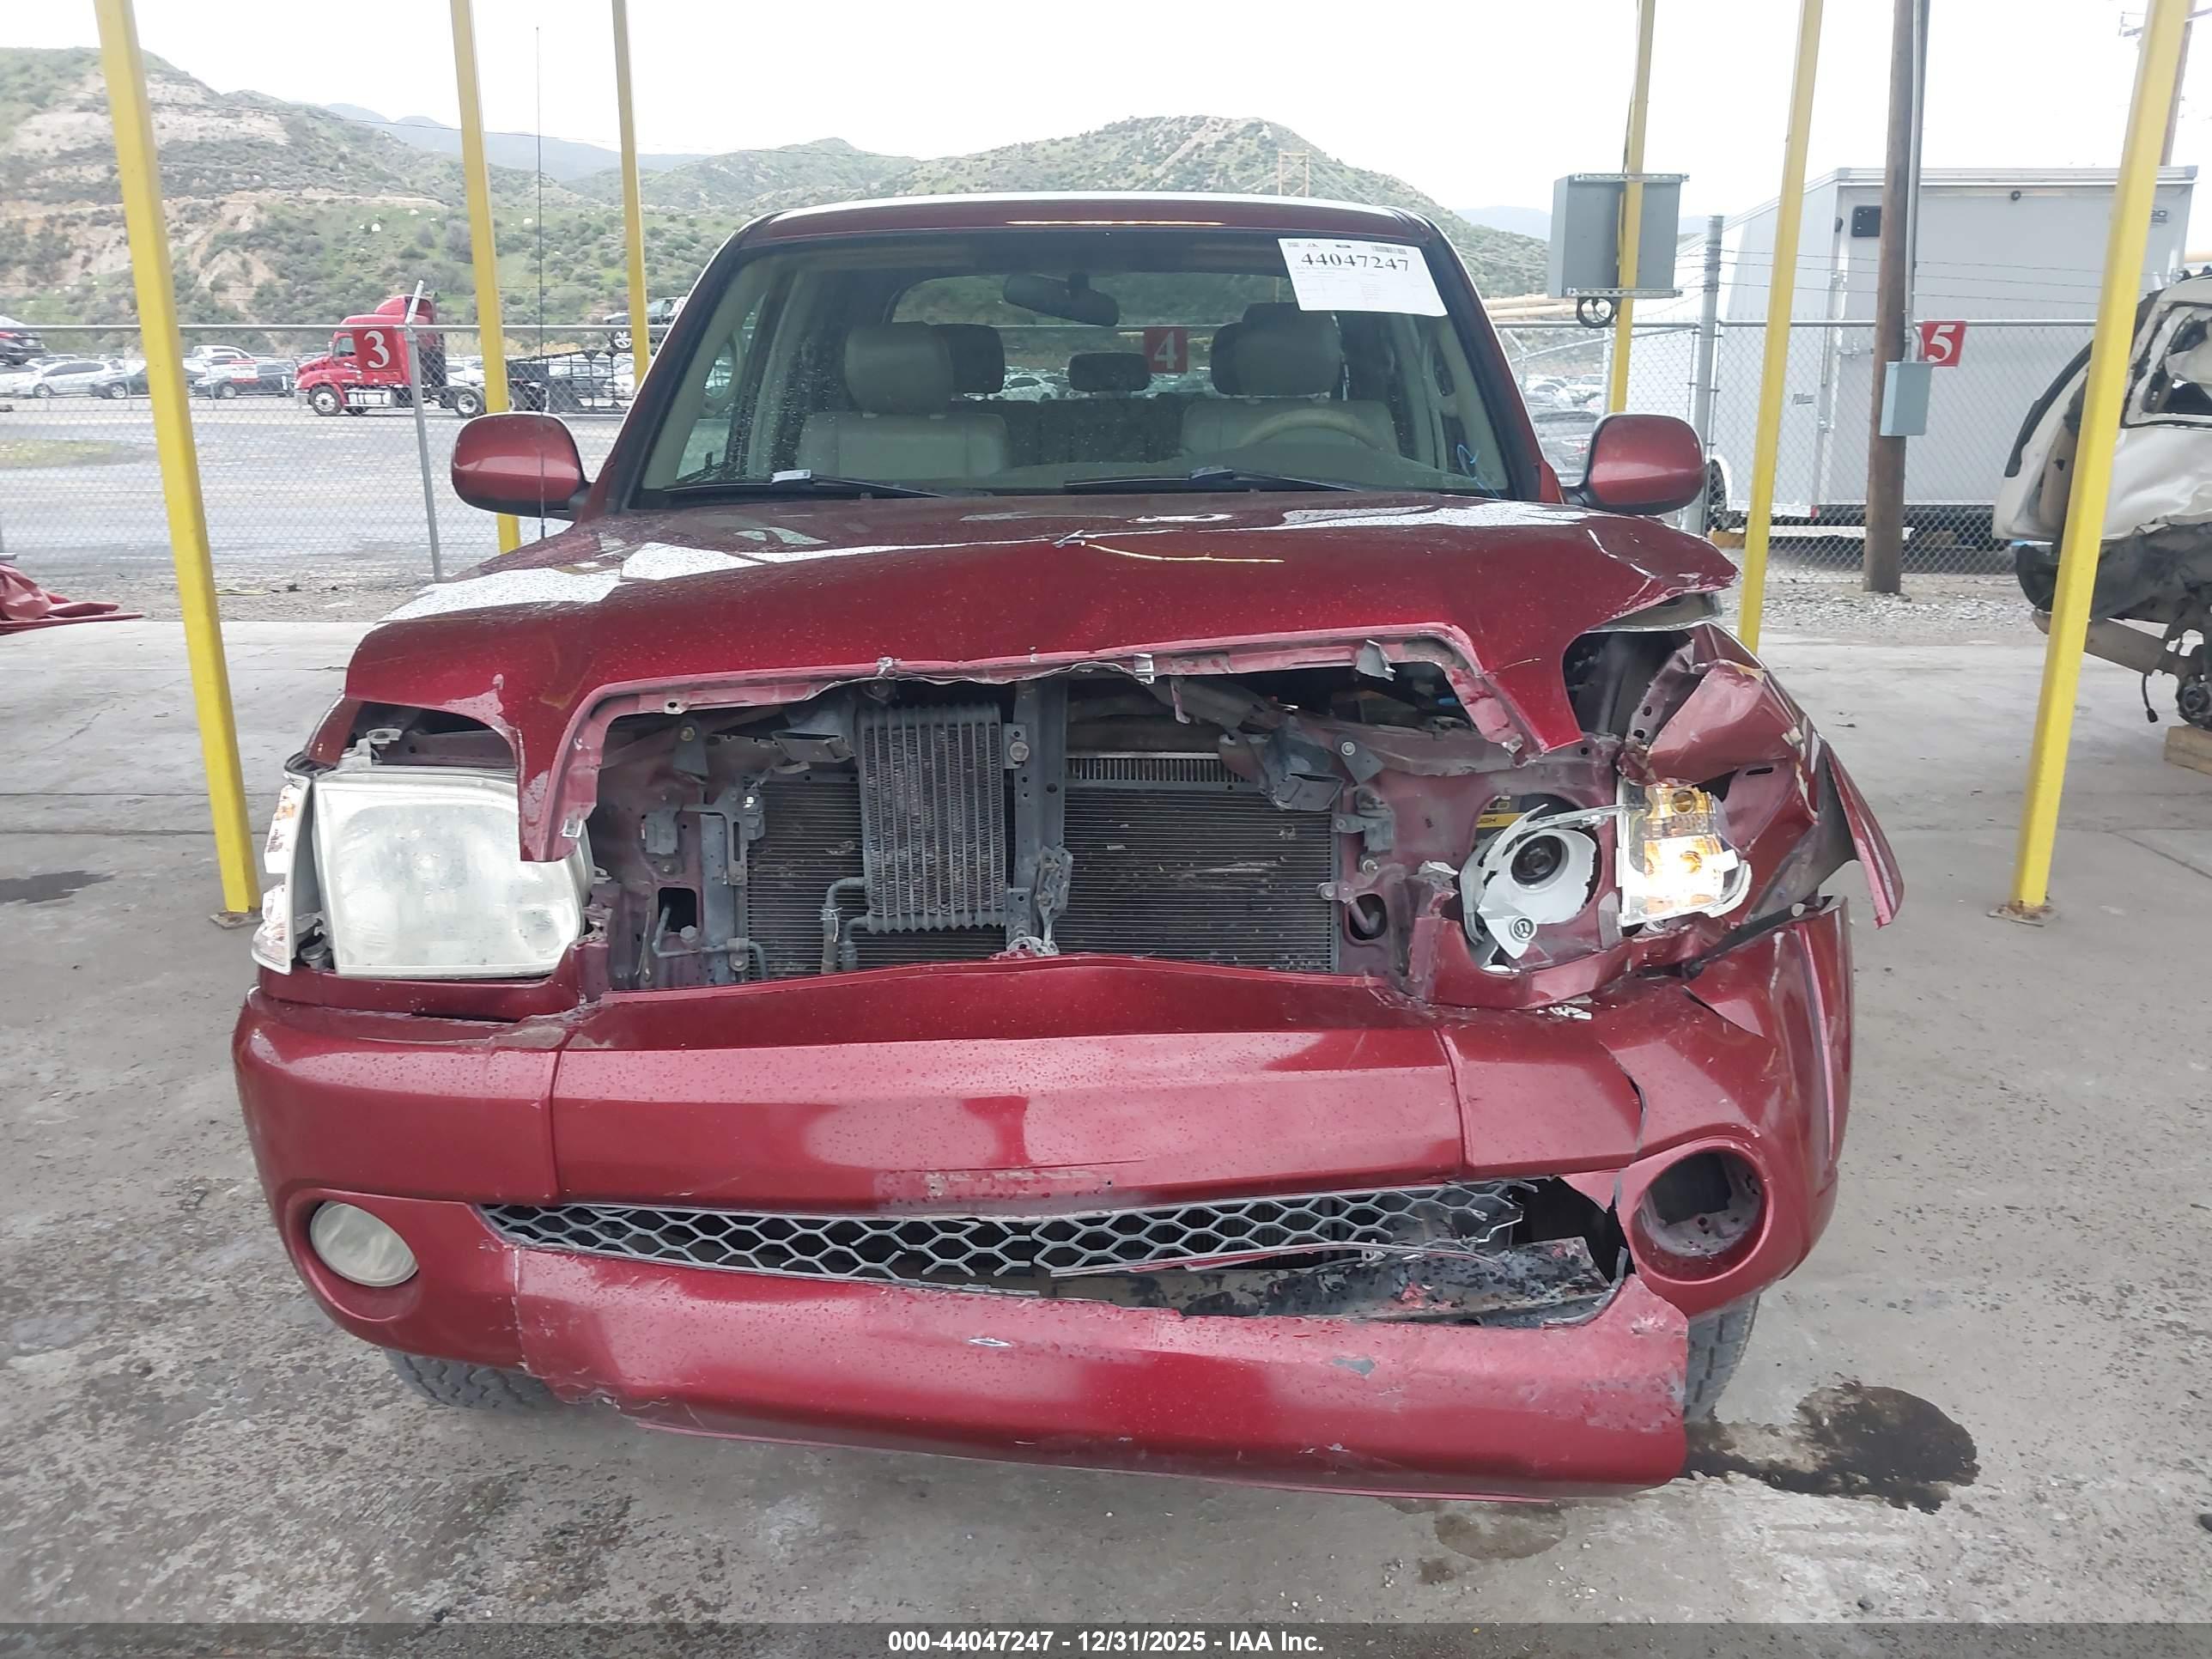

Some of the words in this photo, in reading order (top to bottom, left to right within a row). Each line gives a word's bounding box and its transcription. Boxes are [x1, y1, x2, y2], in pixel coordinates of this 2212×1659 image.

[1301, 252, 1408, 272] 44047247
[363, 330, 390, 368] 3
[1153, 331, 1177, 369] 4
[1927, 325, 1956, 363] 5
